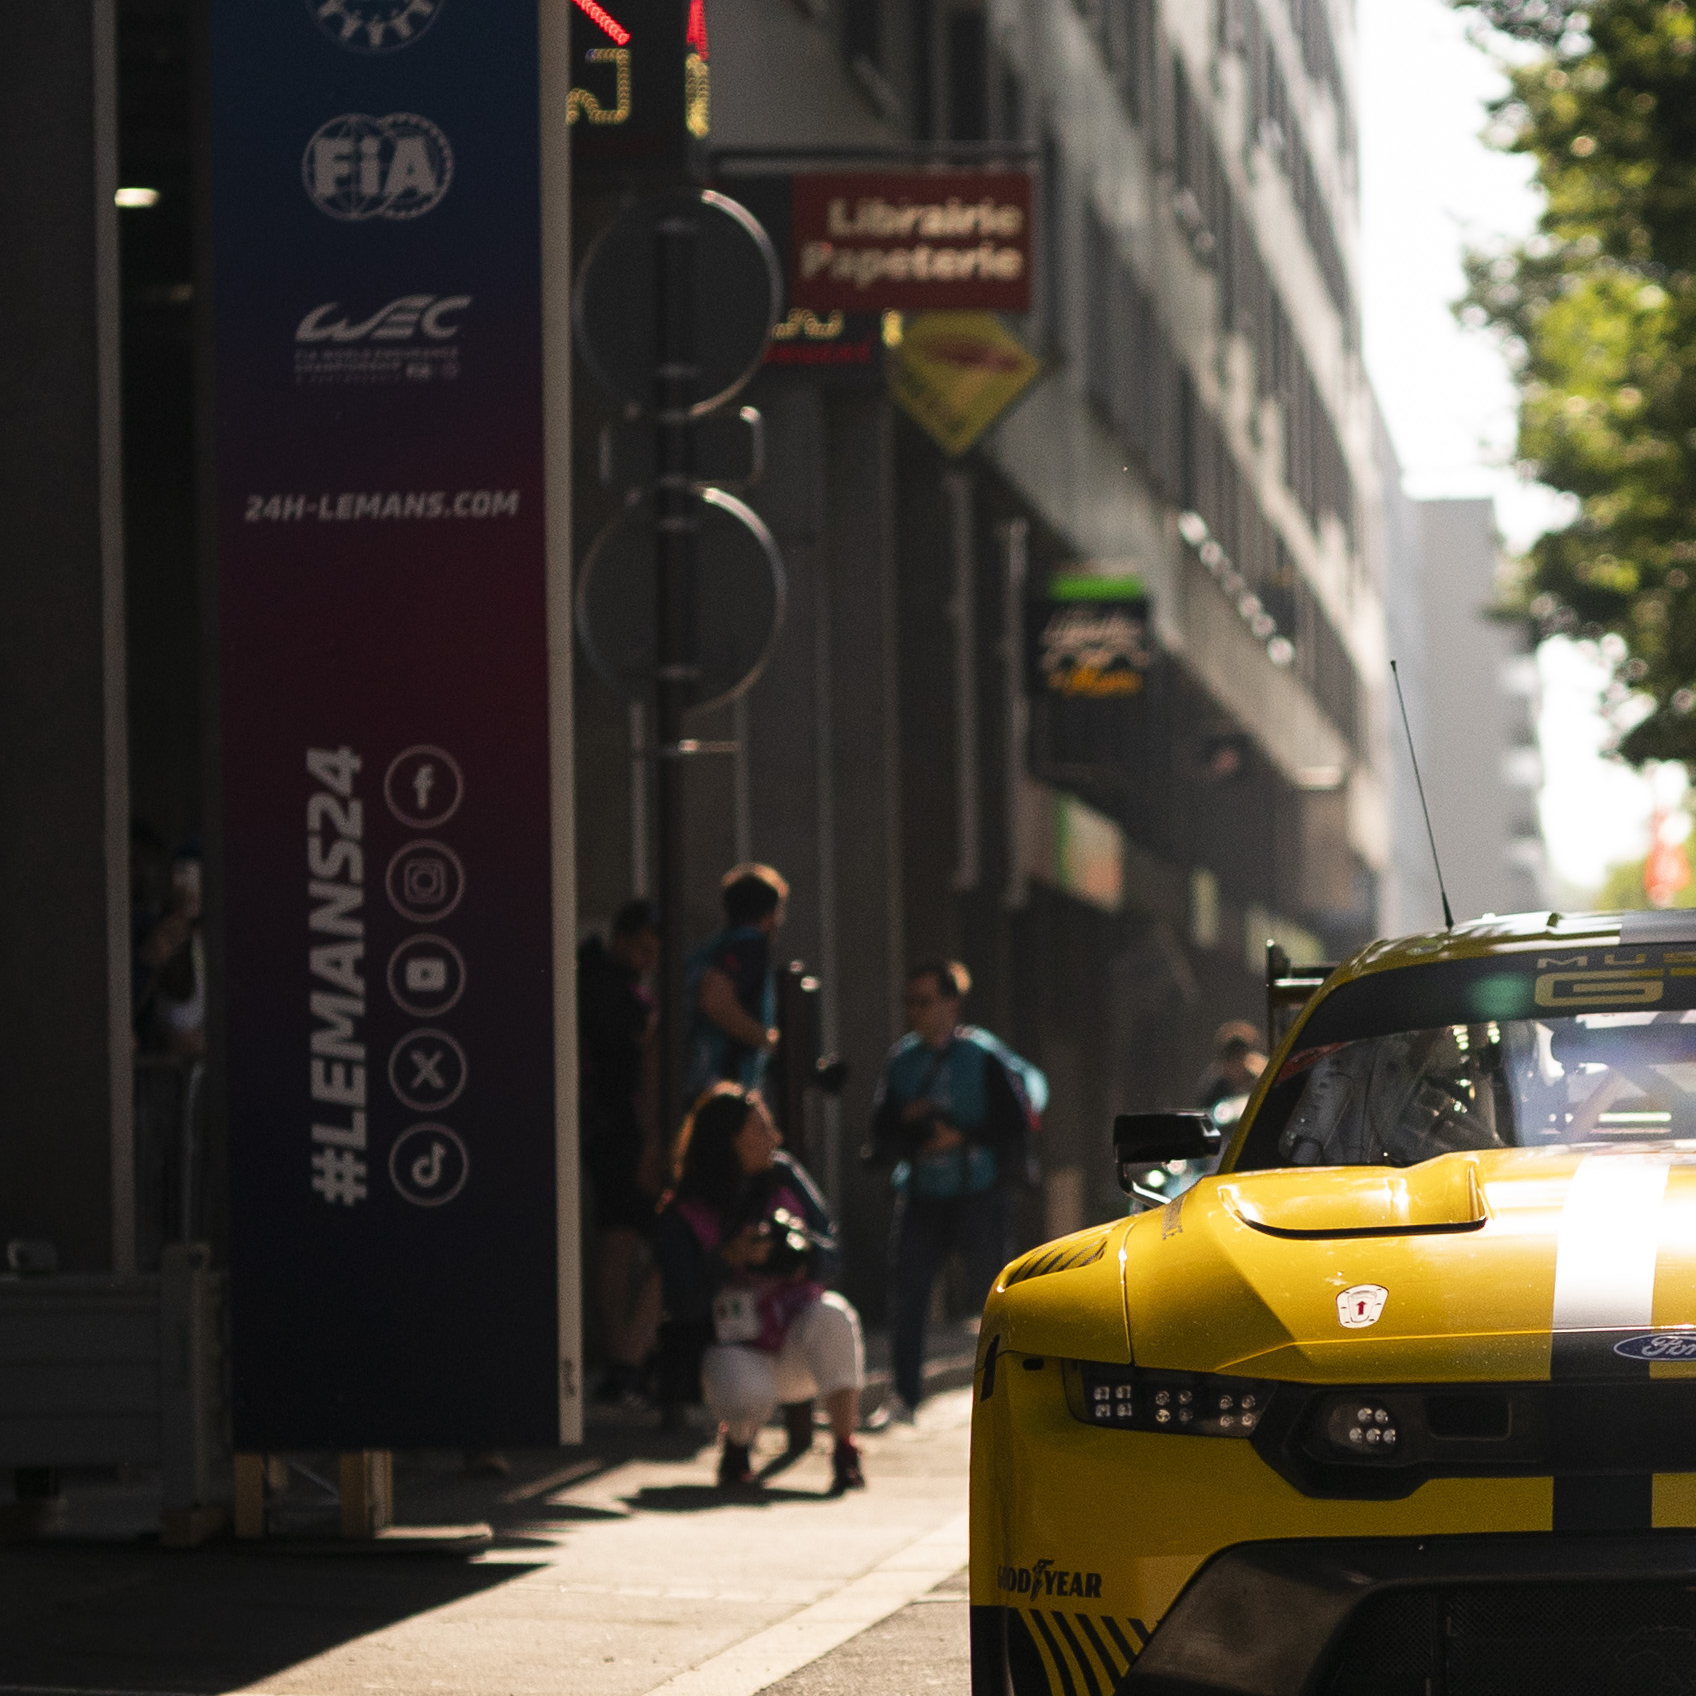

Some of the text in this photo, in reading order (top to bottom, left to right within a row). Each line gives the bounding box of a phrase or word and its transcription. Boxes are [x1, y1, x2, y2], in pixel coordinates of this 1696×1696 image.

[801, 240, 1025, 292] Papeterie
[294, 292, 473, 343] WEC
[243, 490, 520, 522] 24H-LEMANS.COM
[304, 745, 368, 1208] #LEMANS24
